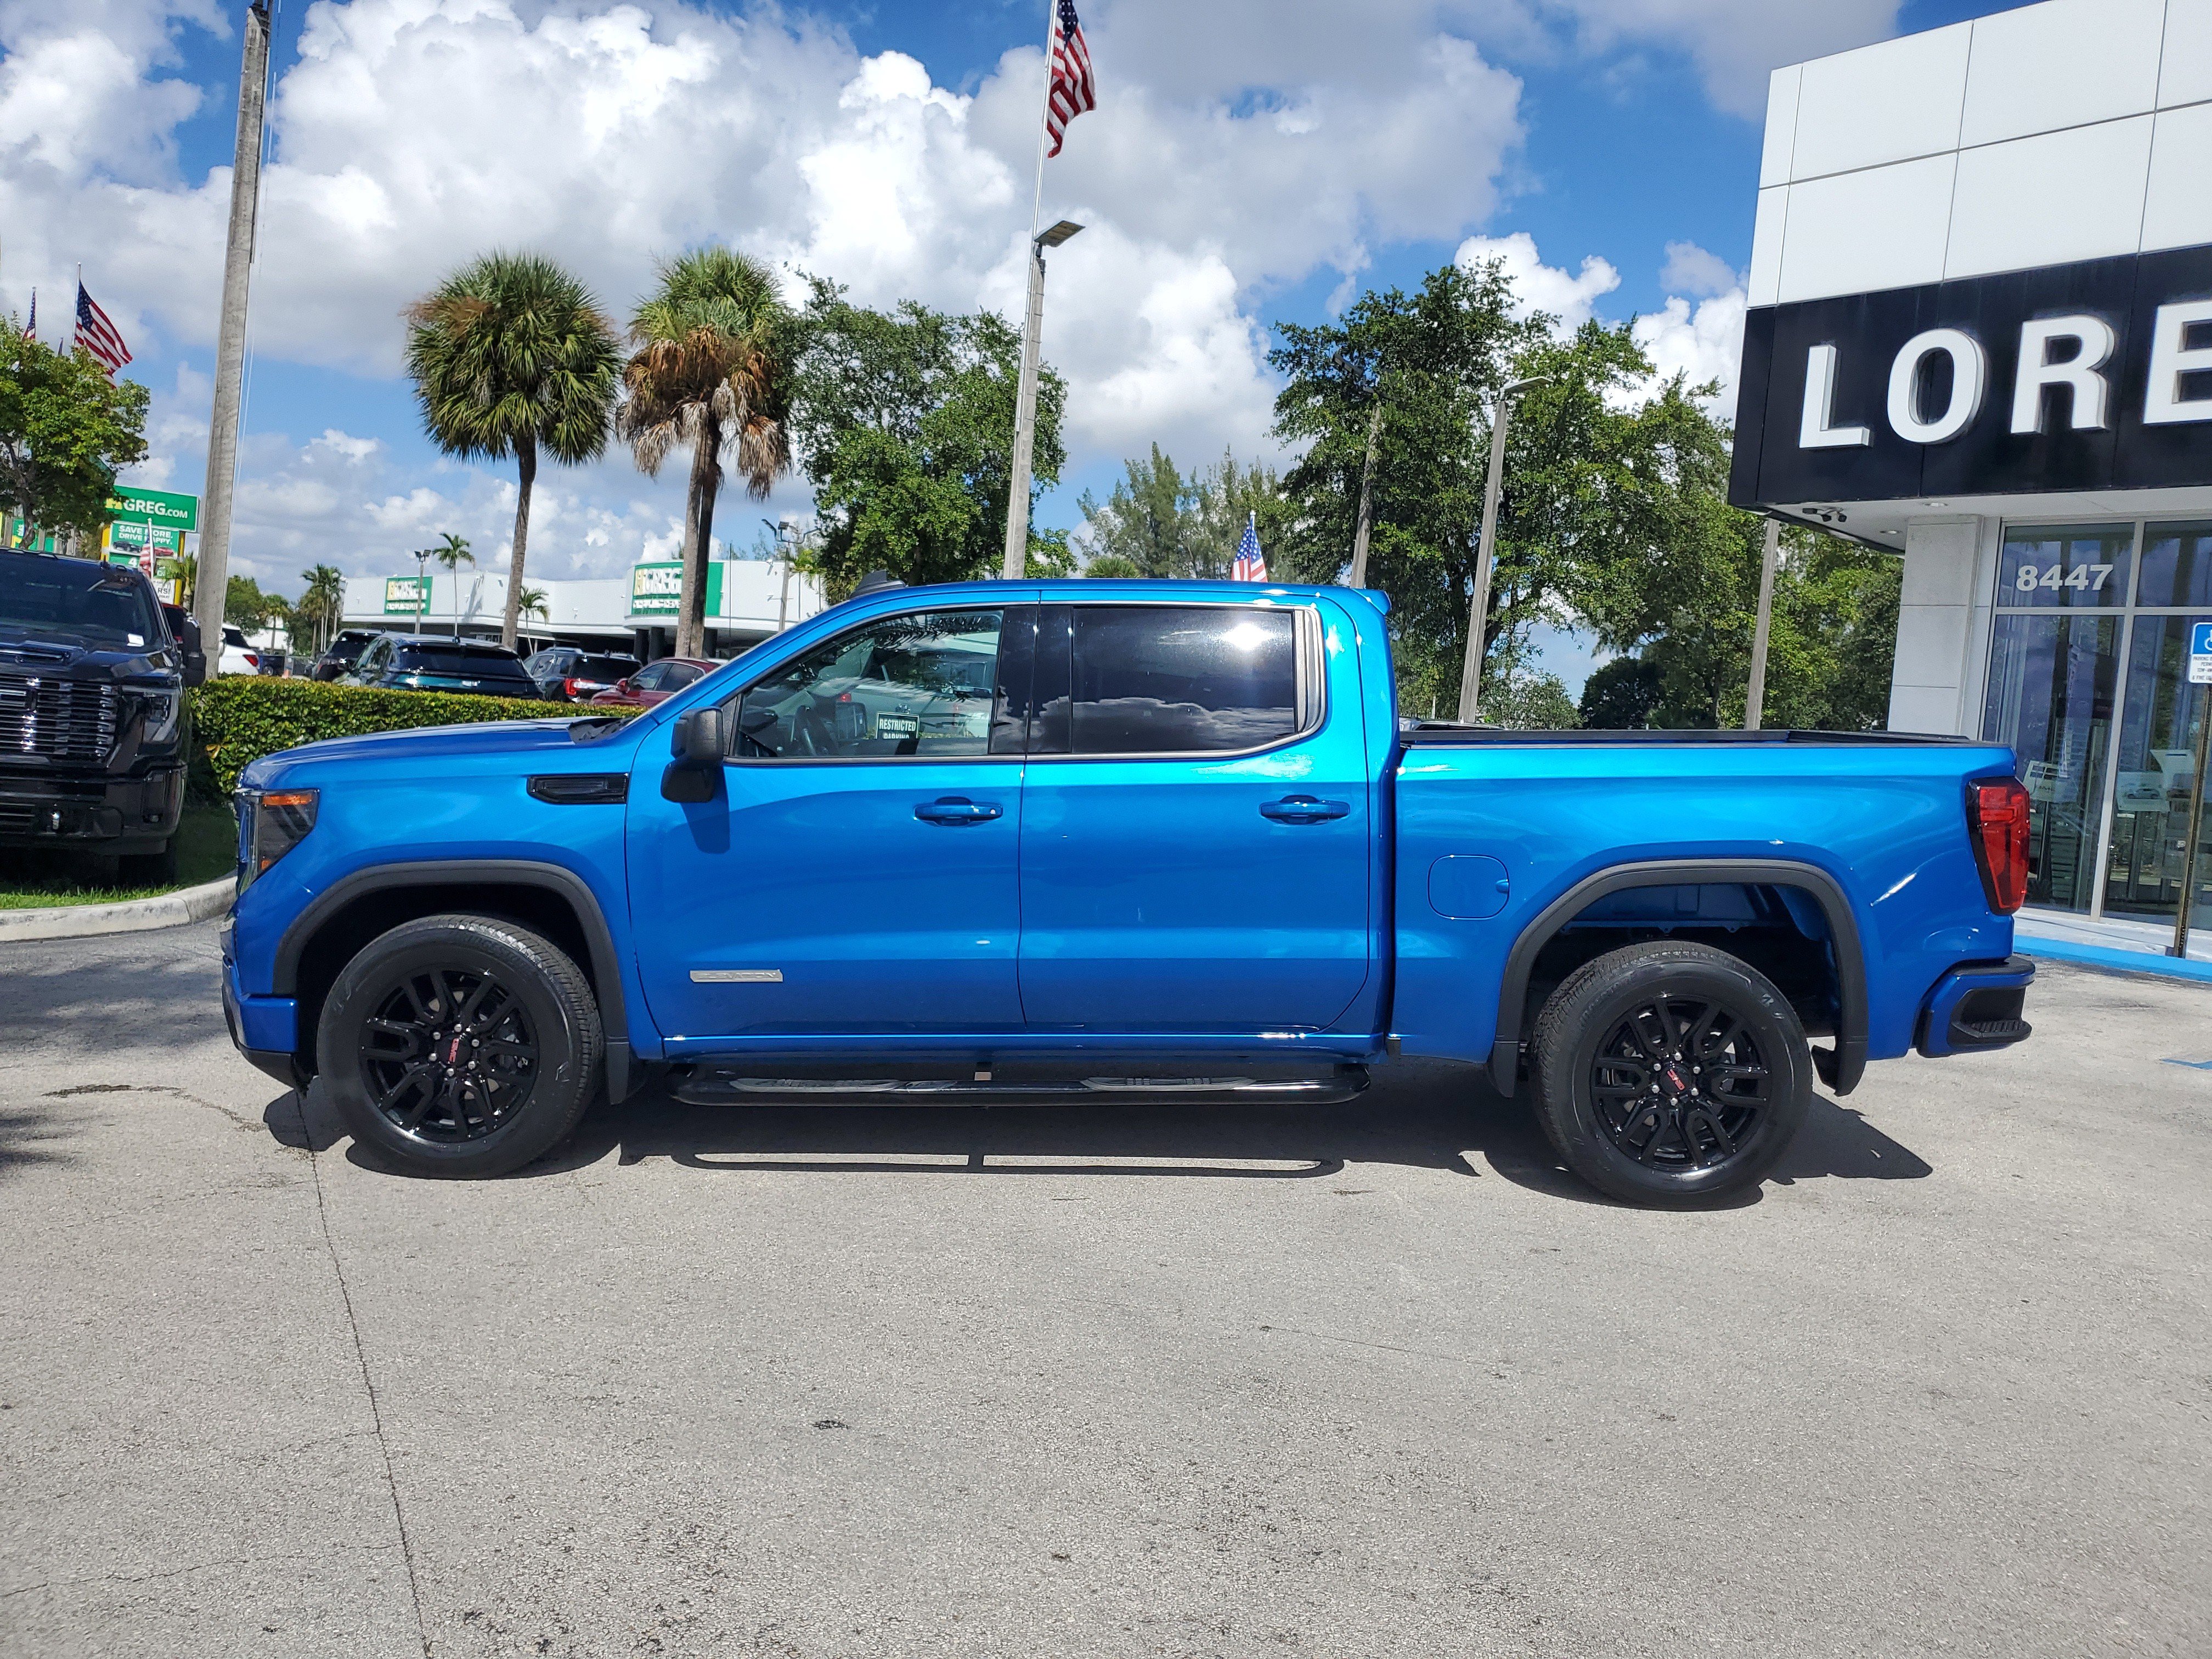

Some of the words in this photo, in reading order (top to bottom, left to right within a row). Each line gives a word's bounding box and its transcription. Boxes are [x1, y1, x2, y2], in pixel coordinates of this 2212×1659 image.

[1799, 300, 2212, 448] LORE
[119, 525, 143, 534] SAVE
[119, 533, 143, 541] DRIVE
[2016, 564, 2114, 591] 8447
[879, 719, 916, 731] RESTRICTED
